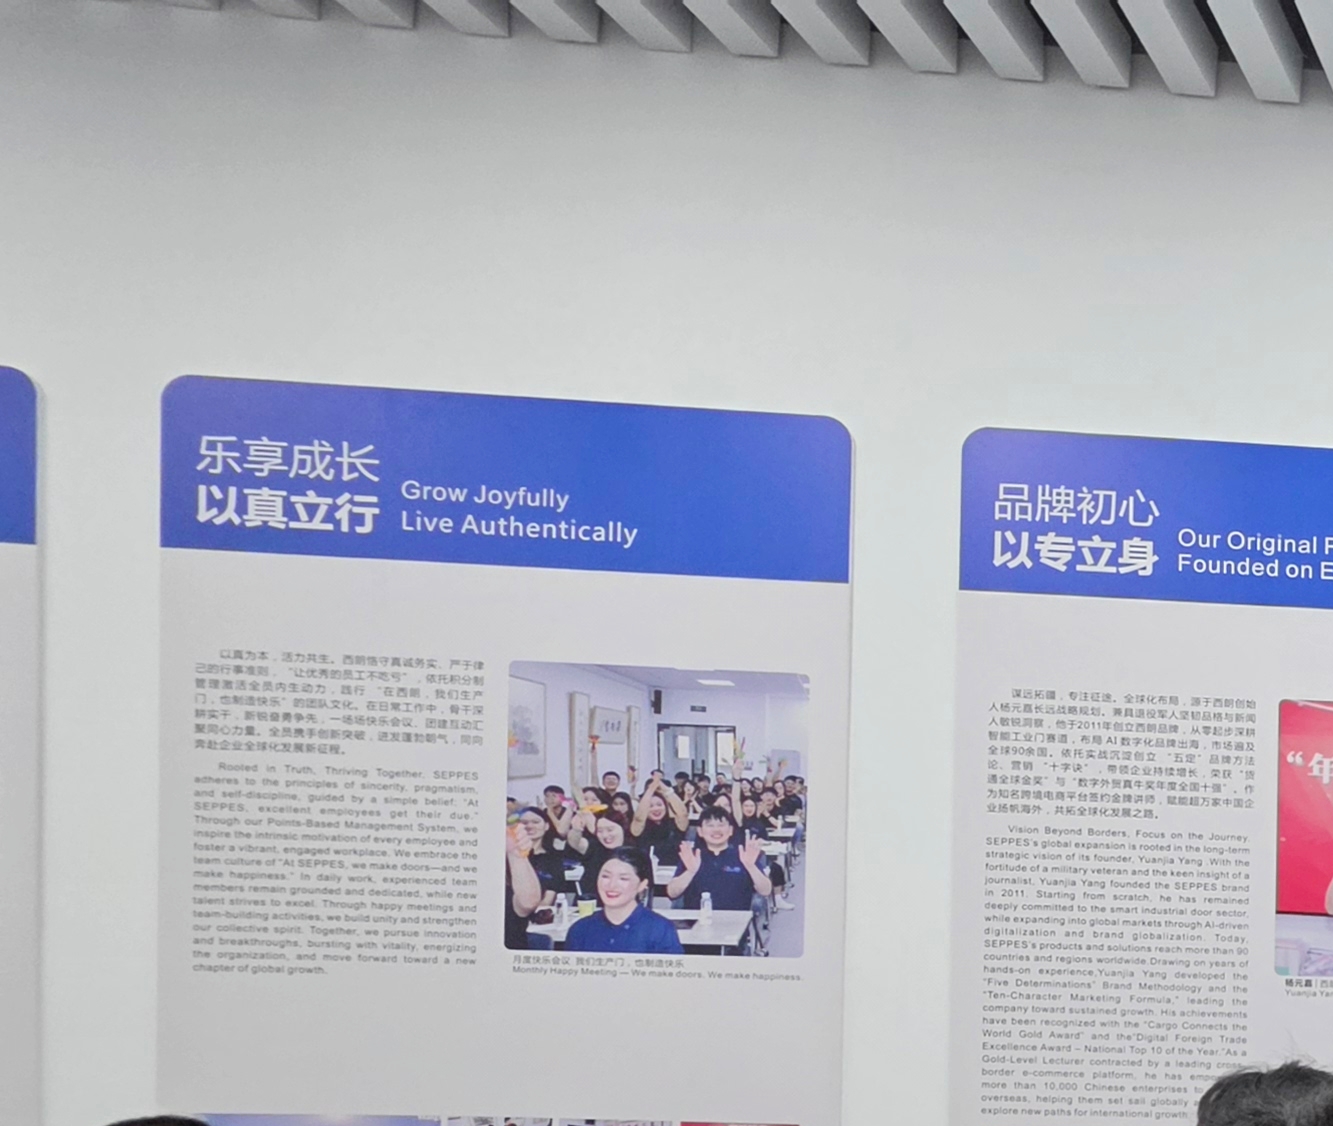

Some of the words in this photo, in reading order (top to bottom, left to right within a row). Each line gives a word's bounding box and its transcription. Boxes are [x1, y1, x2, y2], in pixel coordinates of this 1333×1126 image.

[196, 436, 379, 480] 乐享成长
[196, 485, 379, 532] 以真立行
[401, 480, 467, 501] Grow
[473, 485, 569, 511] Joyfully
[994, 483, 1159, 525] 品牌初心
[402, 510, 453, 532] Live
[460, 515, 637, 547] Authentically
[1178, 528, 1220, 549] Our
[1226, 531, 1316, 555] Original
[993, 531, 1158, 574] 以专立身
[1178, 554, 1278, 576] Founded
[1285, 564, 1312, 578] on
[218, 762, 258, 771] Rooted
[324, 766, 368, 778] Thriving
[433, 770, 478, 780] SEPPES
[1007, 825, 1038, 833] Vision
[1044, 826, 1082, 836] Beyond
[1135, 829, 1165, 838] Focus
[1188, 832, 1203, 840] the
[192, 963, 235, 972] chapter
[237, 964, 249, 972] of
[250, 965, 284, 974] global
[512, 966, 547, 974] Monthly
[549, 967, 578, 976] Happy
[580, 967, 617, 977] Meeting
[1284, 989, 1316, 997] Yuanjia
